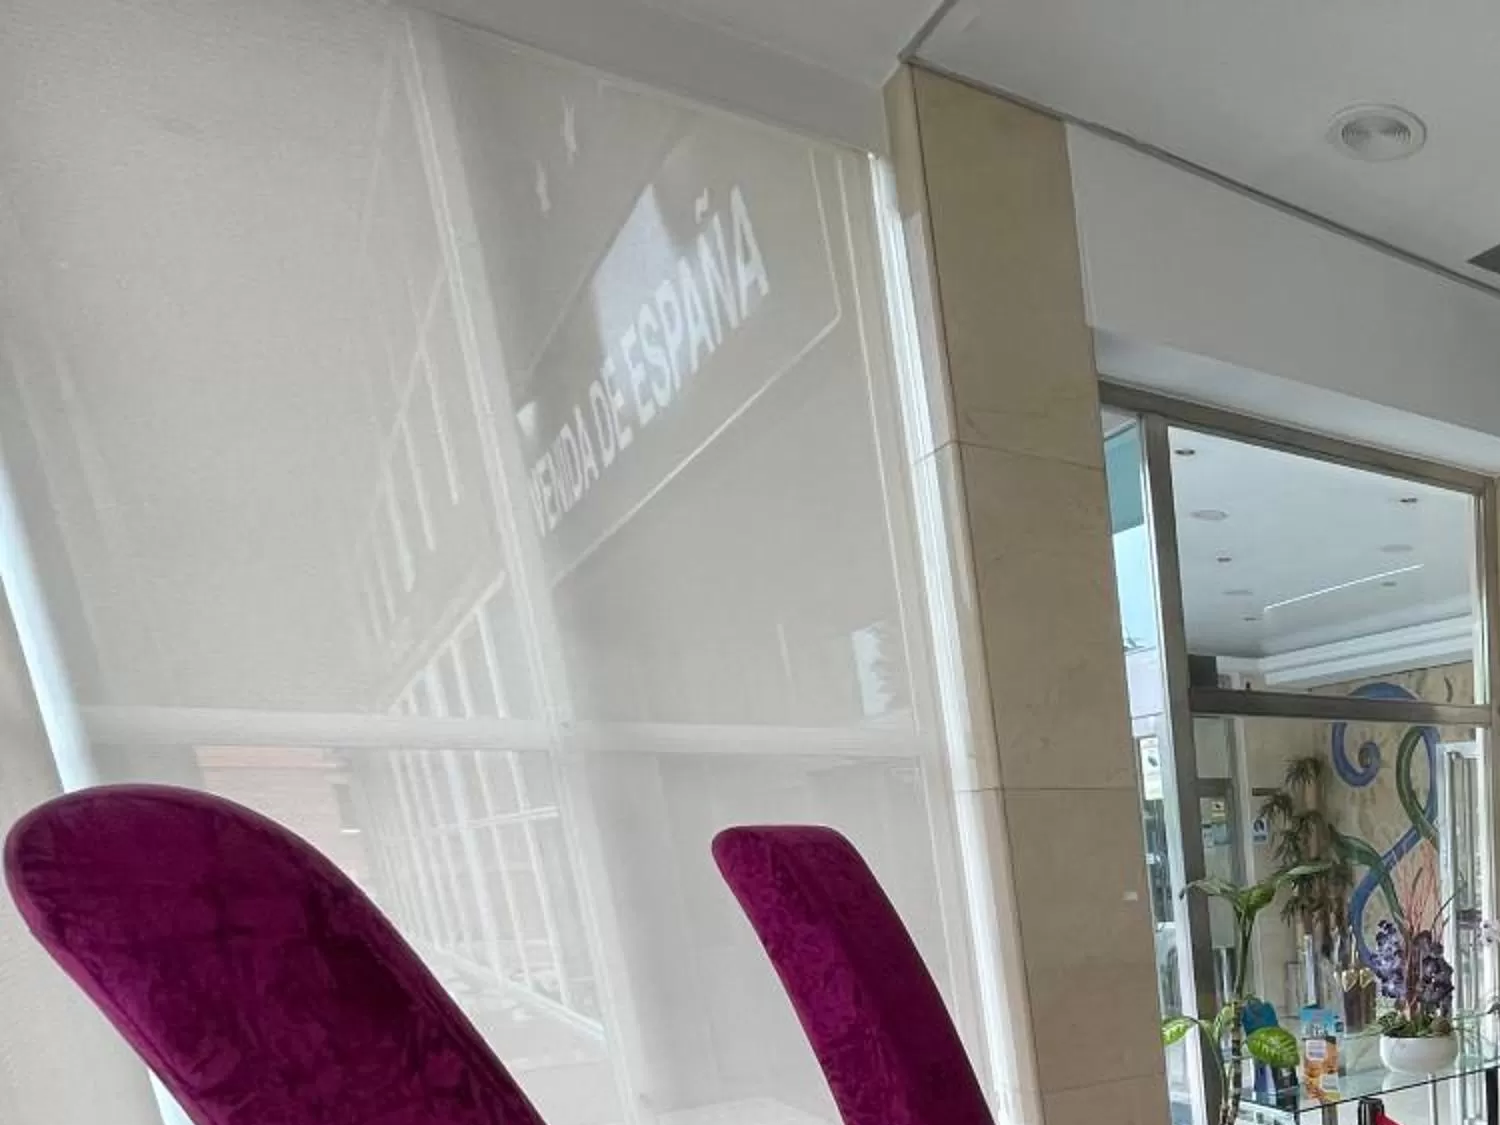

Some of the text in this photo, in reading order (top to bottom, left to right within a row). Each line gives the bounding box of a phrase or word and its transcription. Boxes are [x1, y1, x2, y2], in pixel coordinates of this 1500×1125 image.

[529, 184, 770, 538] VENIDA DE ESPAÑA
